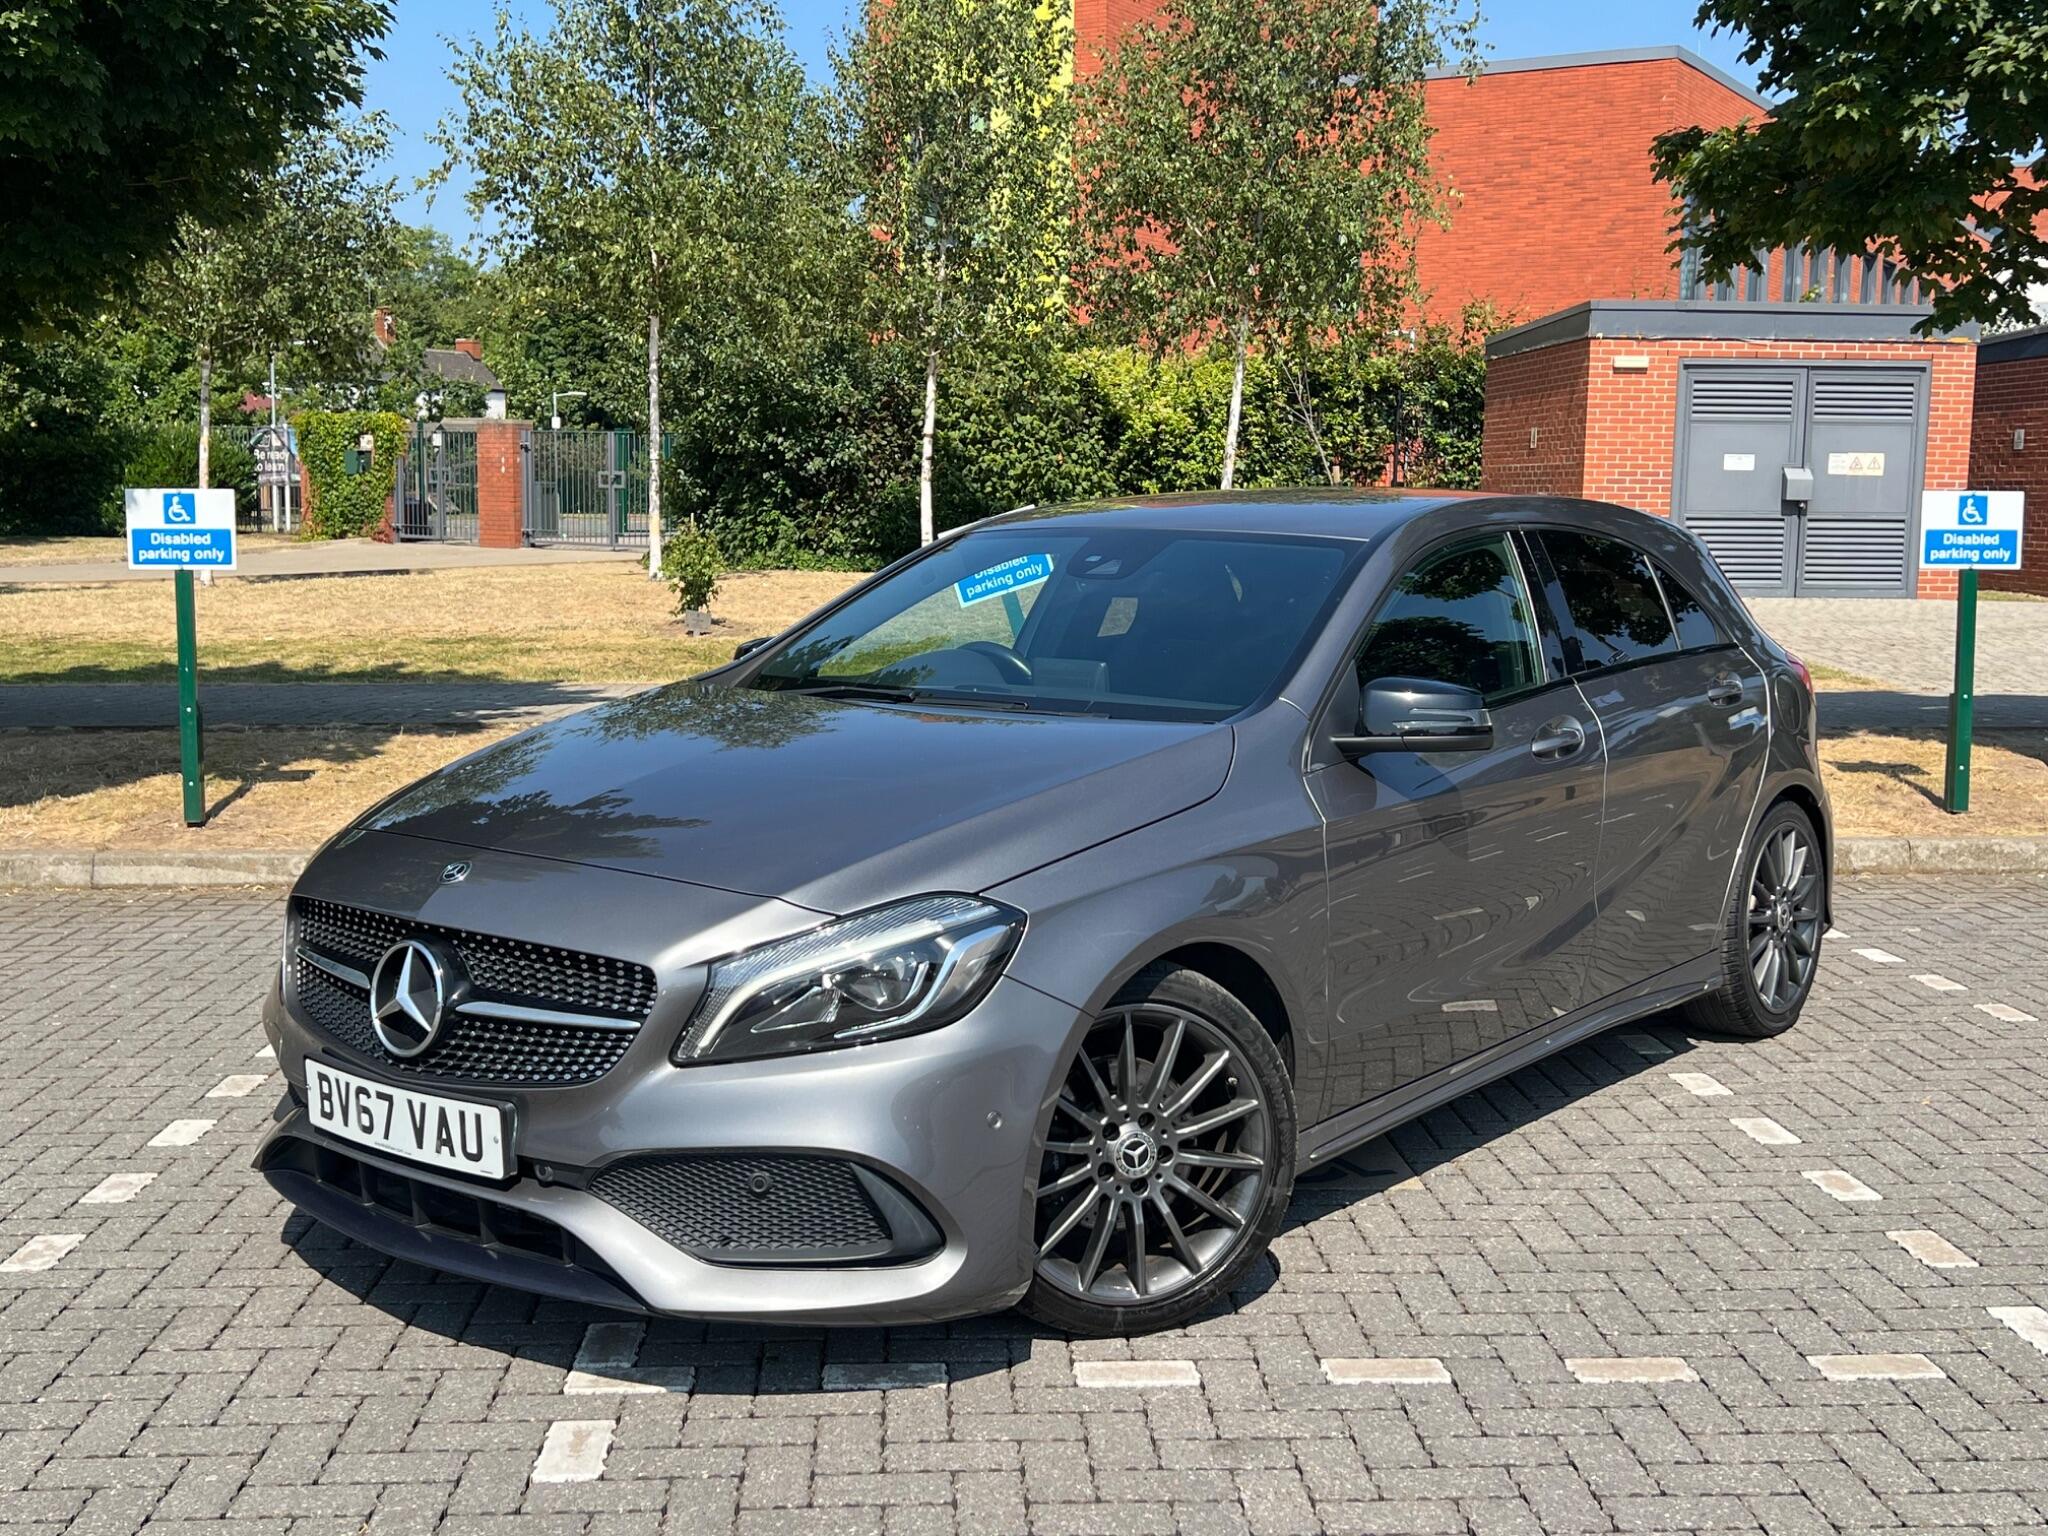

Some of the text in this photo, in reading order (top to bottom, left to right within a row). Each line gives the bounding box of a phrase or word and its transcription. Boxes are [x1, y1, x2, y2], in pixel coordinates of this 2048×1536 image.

[150, 532, 212, 545] Disabled
[1943, 533, 2000, 545] Disabled
[138, 547, 225, 562] parking only
[1930, 547, 2011, 562] parking only
[966, 563, 1043, 598] parking only
[317, 1071, 483, 1163] BV67 VAU
